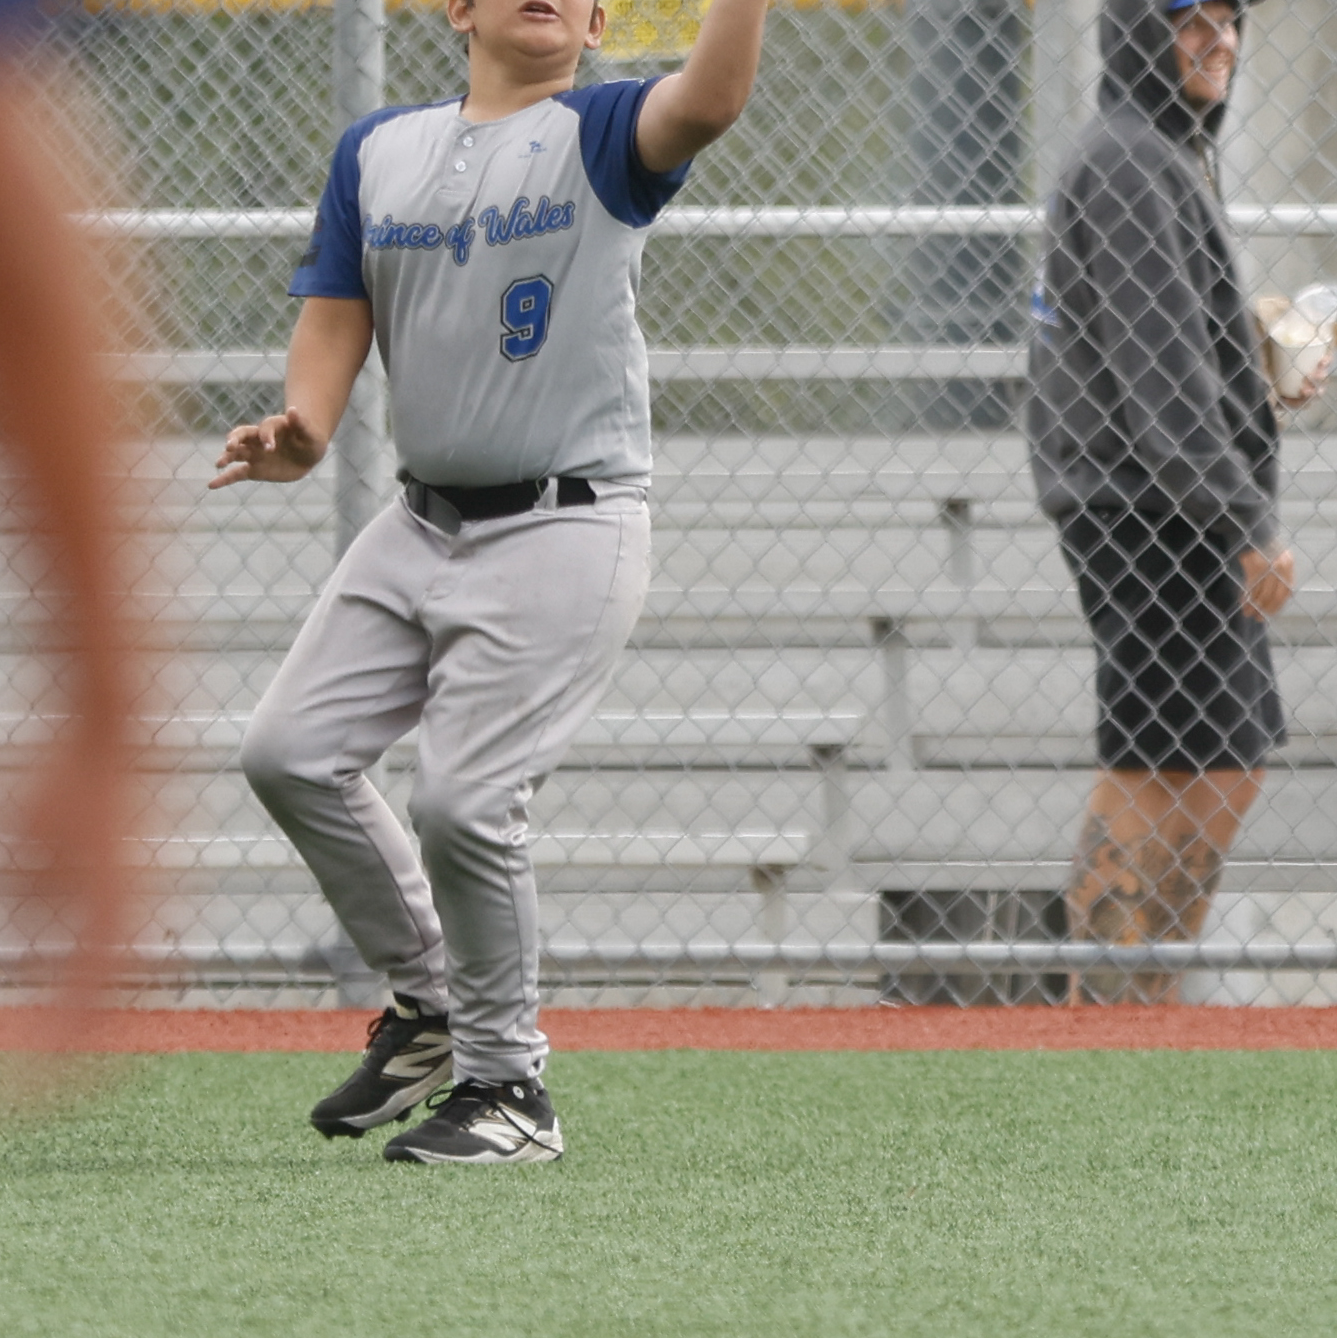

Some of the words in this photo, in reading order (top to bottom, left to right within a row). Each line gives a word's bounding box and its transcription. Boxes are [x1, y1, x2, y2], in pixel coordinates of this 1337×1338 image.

[445, 217, 476, 266] of
[477, 195, 576, 247] Wales
[500, 274, 554, 363] 9
